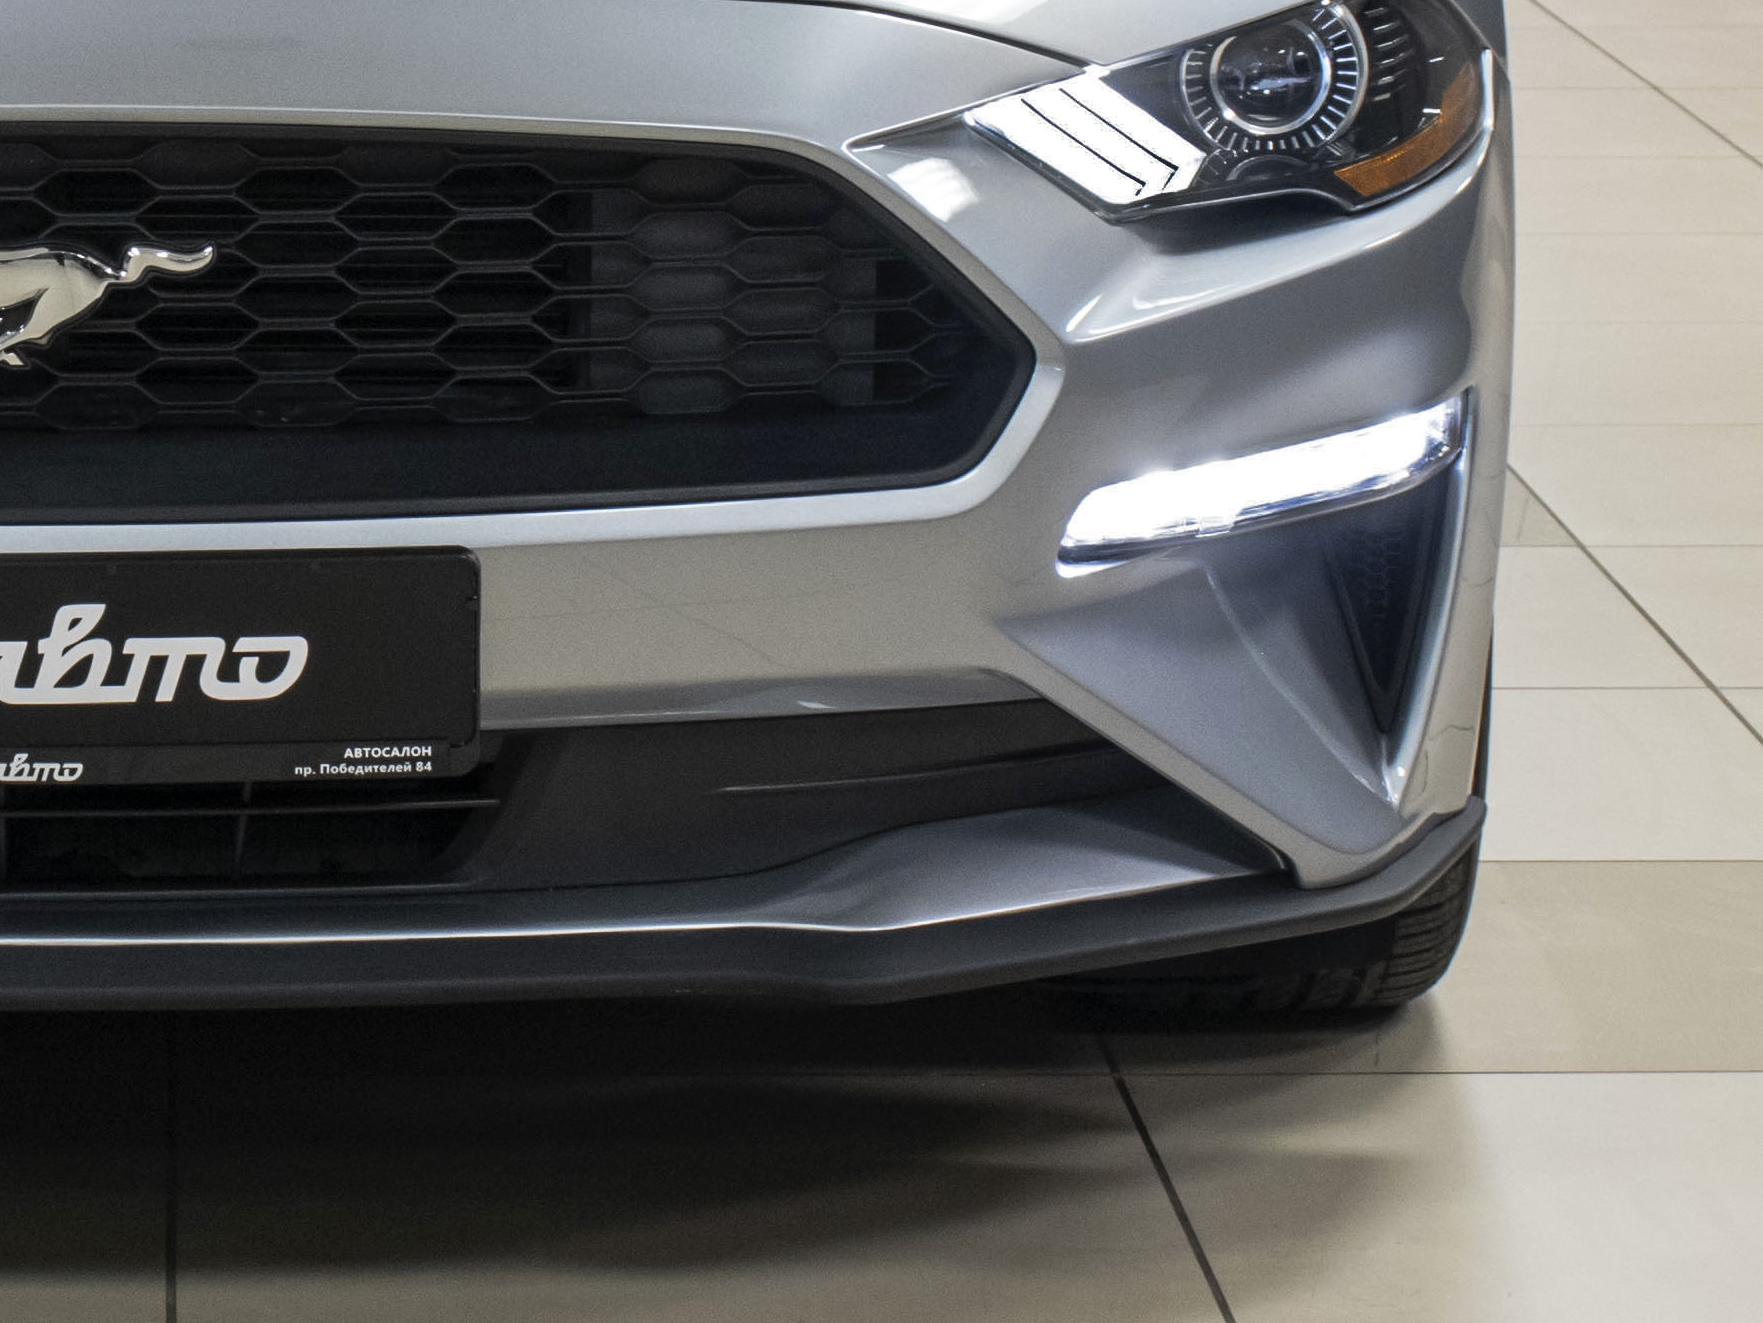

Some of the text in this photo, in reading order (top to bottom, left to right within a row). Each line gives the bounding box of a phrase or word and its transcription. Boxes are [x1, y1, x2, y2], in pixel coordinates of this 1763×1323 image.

[344, 746, 432, 759] АВТОСАЛОН
[294, 761, 433, 777] пр. Победителей 84
